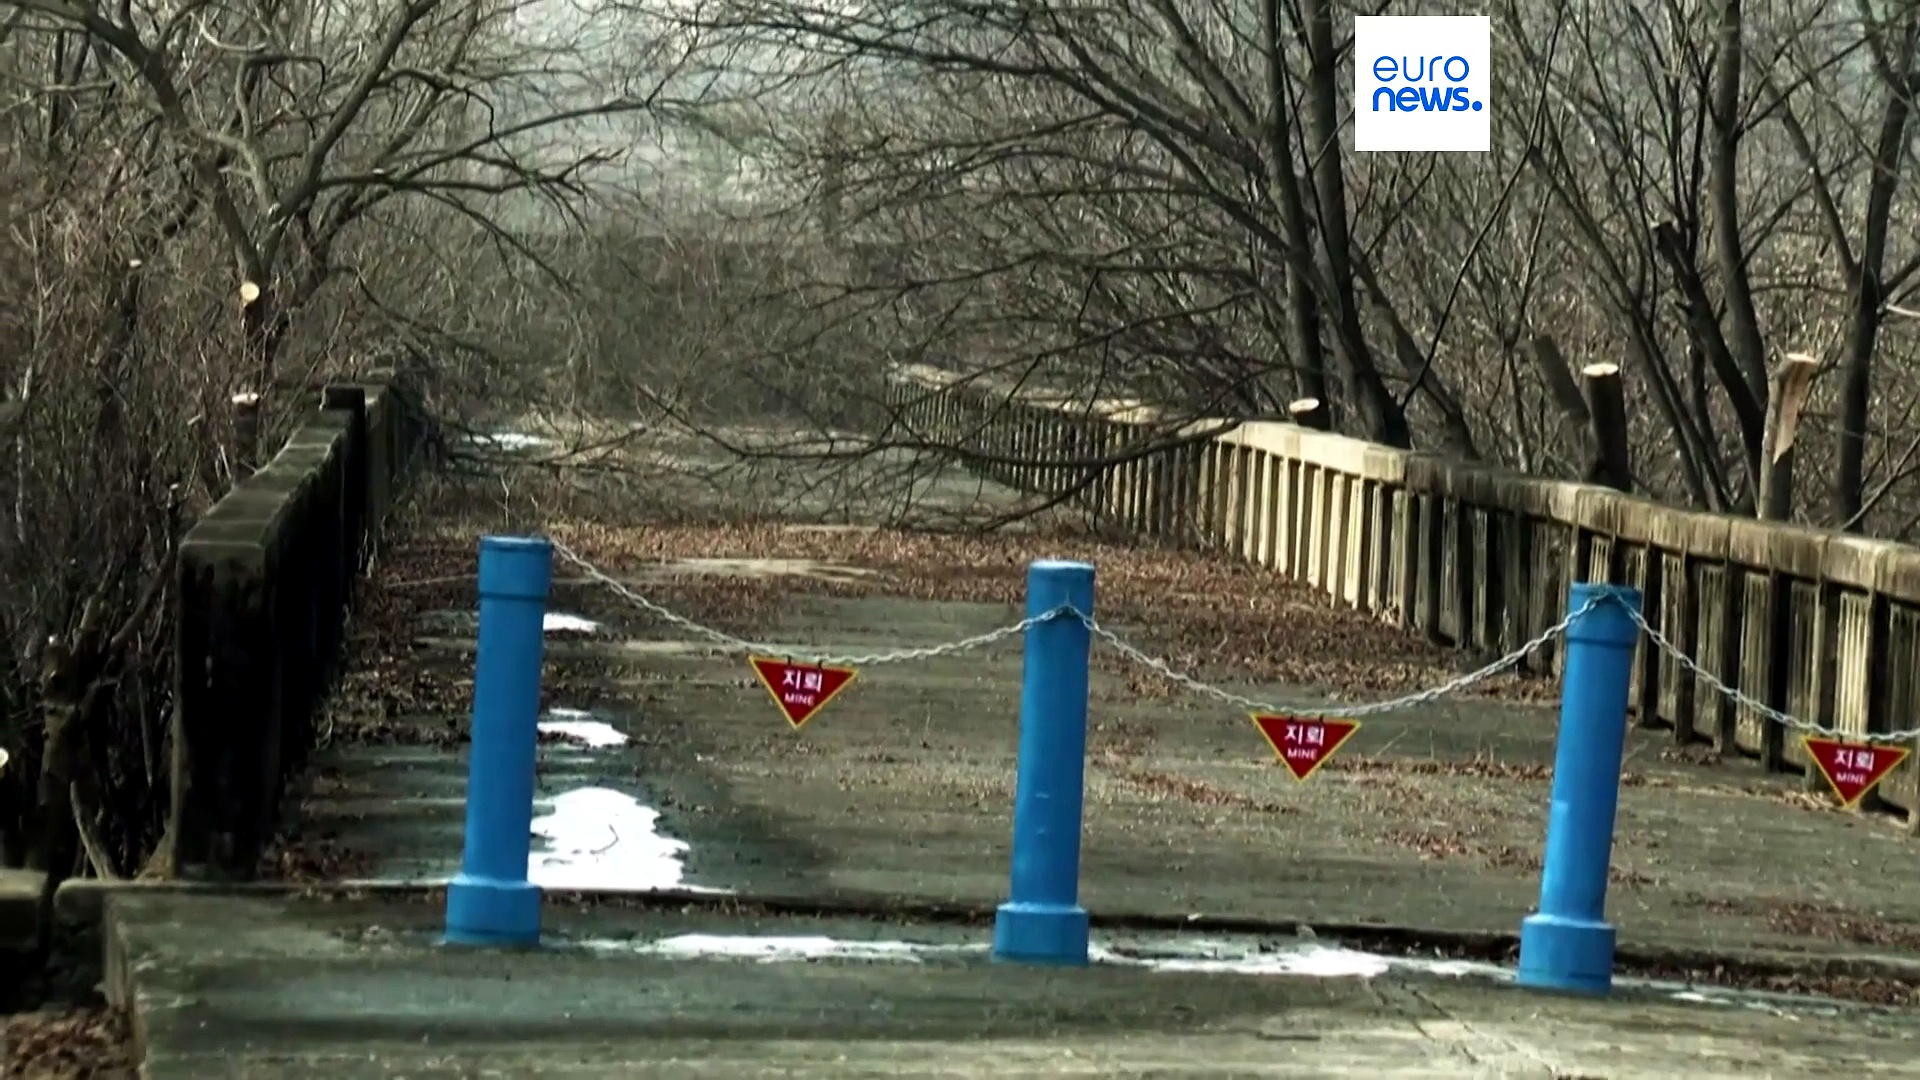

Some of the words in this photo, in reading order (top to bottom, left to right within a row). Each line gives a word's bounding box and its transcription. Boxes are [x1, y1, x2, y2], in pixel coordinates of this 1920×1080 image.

[782, 669, 823, 693] 지뢰
[784, 692, 815, 707] MINE
[1284, 724, 1325, 747] 지뢰
[1287, 747, 1318, 760] MINE
[1834, 748, 1875, 773] 지뢰
[1836, 772, 1866, 785] MINE
